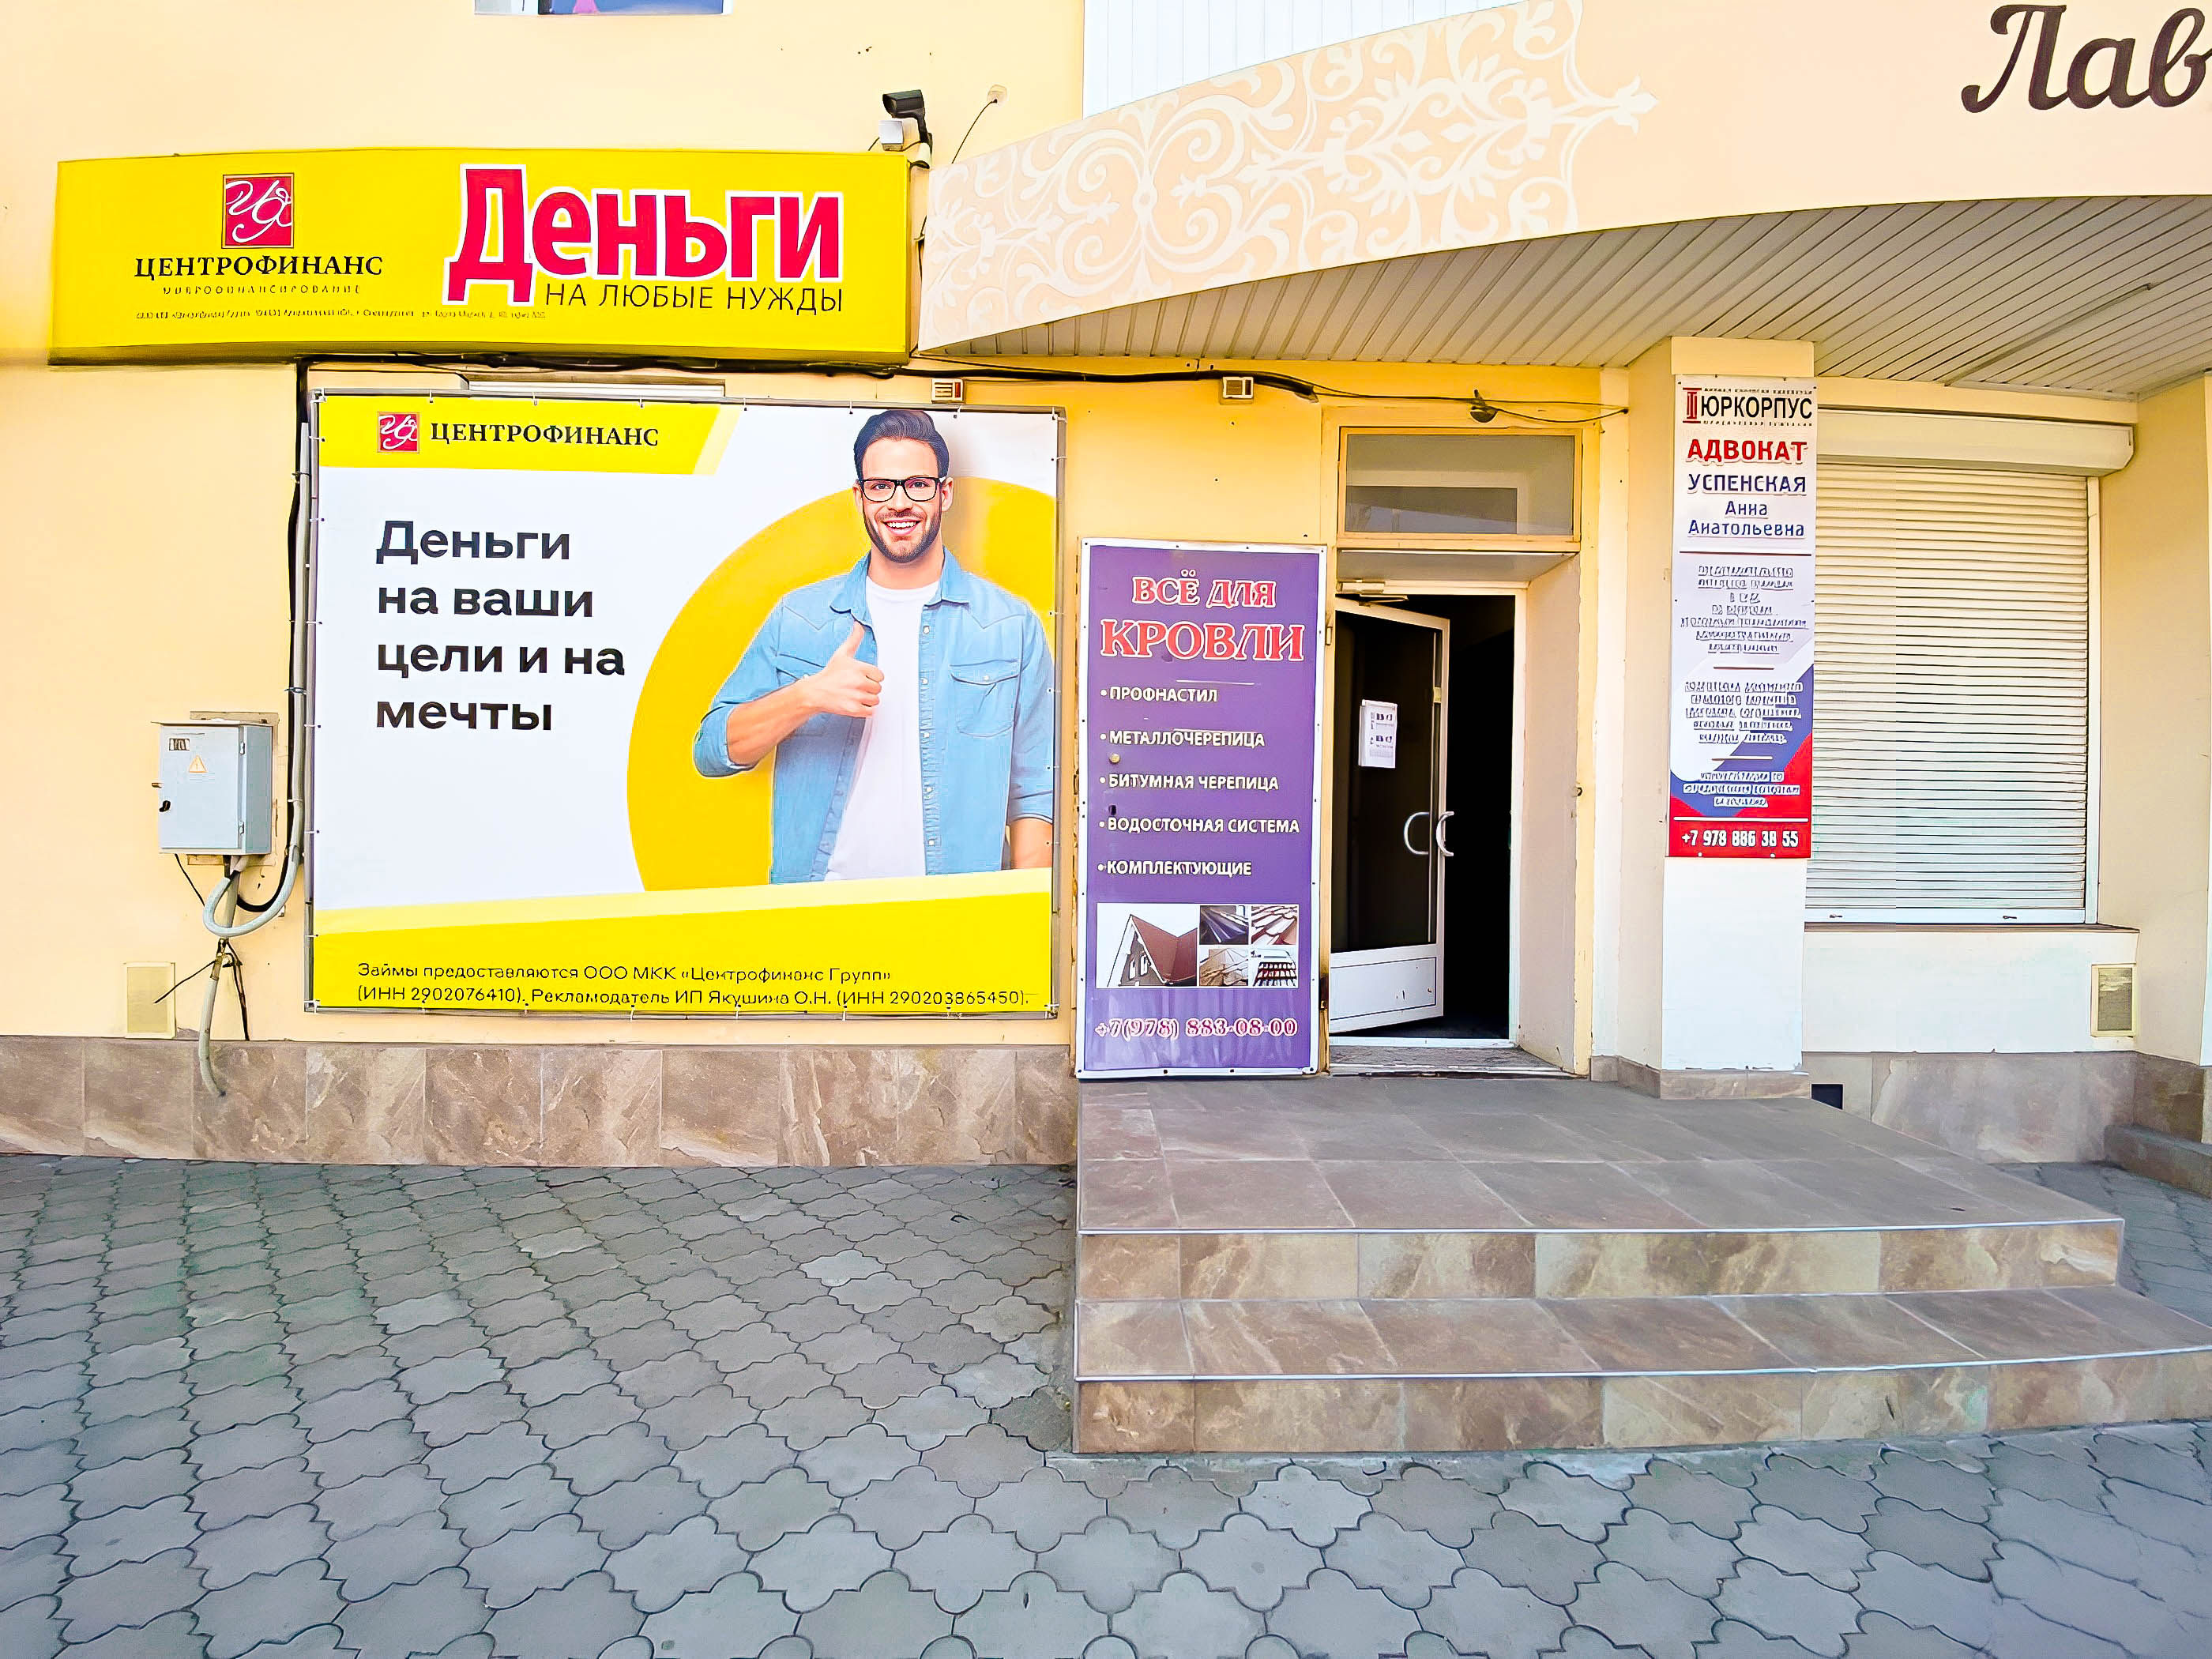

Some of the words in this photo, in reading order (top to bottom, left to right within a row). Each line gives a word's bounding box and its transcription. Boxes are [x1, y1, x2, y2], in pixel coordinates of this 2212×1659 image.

[445, 167, 842, 303] Деньги
[134, 254, 383, 281] ЦЕНТРОФИНАНС
[545, 283, 587, 307] НА
[599, 284, 713, 309] ЛЮБЫЕ
[727, 286, 843, 316] НУЖДЫ
[1701, 395, 1812, 419] ЮРКОРПУС
[431, 422, 659, 447] ЦЕНТРОФИНАНС
[1687, 438, 1808, 462] АДВОКАТ
[1687, 473, 1806, 493] УСПЕНСКАЯ
[1725, 500, 1768, 516] Анна
[1688, 519, 1805, 536] Анатольевна
[375, 520, 570, 565] Деньги
[1132, 569, 1200, 606] ВСЁ
[1206, 579, 1277, 609] ДЛЯ
[378, 586, 438, 615] на
[453, 587, 593, 618] ваши
[1100, 619, 1305, 662] КРОВЛИ
[378, 643, 503, 679] цели
[519, 645, 547, 674] и
[564, 645, 625, 676] на
[1109, 686, 1218, 702] ПРОФНАСТИЛ
[376, 700, 552, 731] мечты
[1109, 730, 1266, 748] МЕТАЛЛОЧЕРЕПИЦА
[1108, 773, 1194, 788] БИТУМНАЯ
[1198, 776, 1279, 792] ЧЕРЕПИЦА
[1108, 817, 1224, 833] ВОДОСТОЧНАЯ
[1228, 818, 1300, 833] СИСТЕМА
[1681, 830, 1698, 846] +7
[1702, 830, 1727, 847] 978
[1761, 830, 1777, 847] 38
[1782, 830, 1799, 847] 55
[1107, 860, 1253, 878] КОМПЛЕКТУЮЩИЕ
[358, 962, 418, 977] Займы
[423, 966, 578, 980] предоставляются
[584, 965, 628, 980] ООО
[634, 966, 676, 980] МКК
[681, 967, 824, 984] «Центрофинанс
[830, 968, 890, 984] Групп»
[358, 984, 405, 1001] (ИНН
[532, 988, 670, 1005] Рекламодатель
[675, 990, 702, 1003] ИП
[709, 990, 789, 1006] Якушина
[794, 991, 831, 1004] О.Н.
[837, 990, 884, 1006] (ИНН
[1095, 1018, 1179, 1042] +7(978)
[1185, 1018, 1298, 1036] 883-08-00
